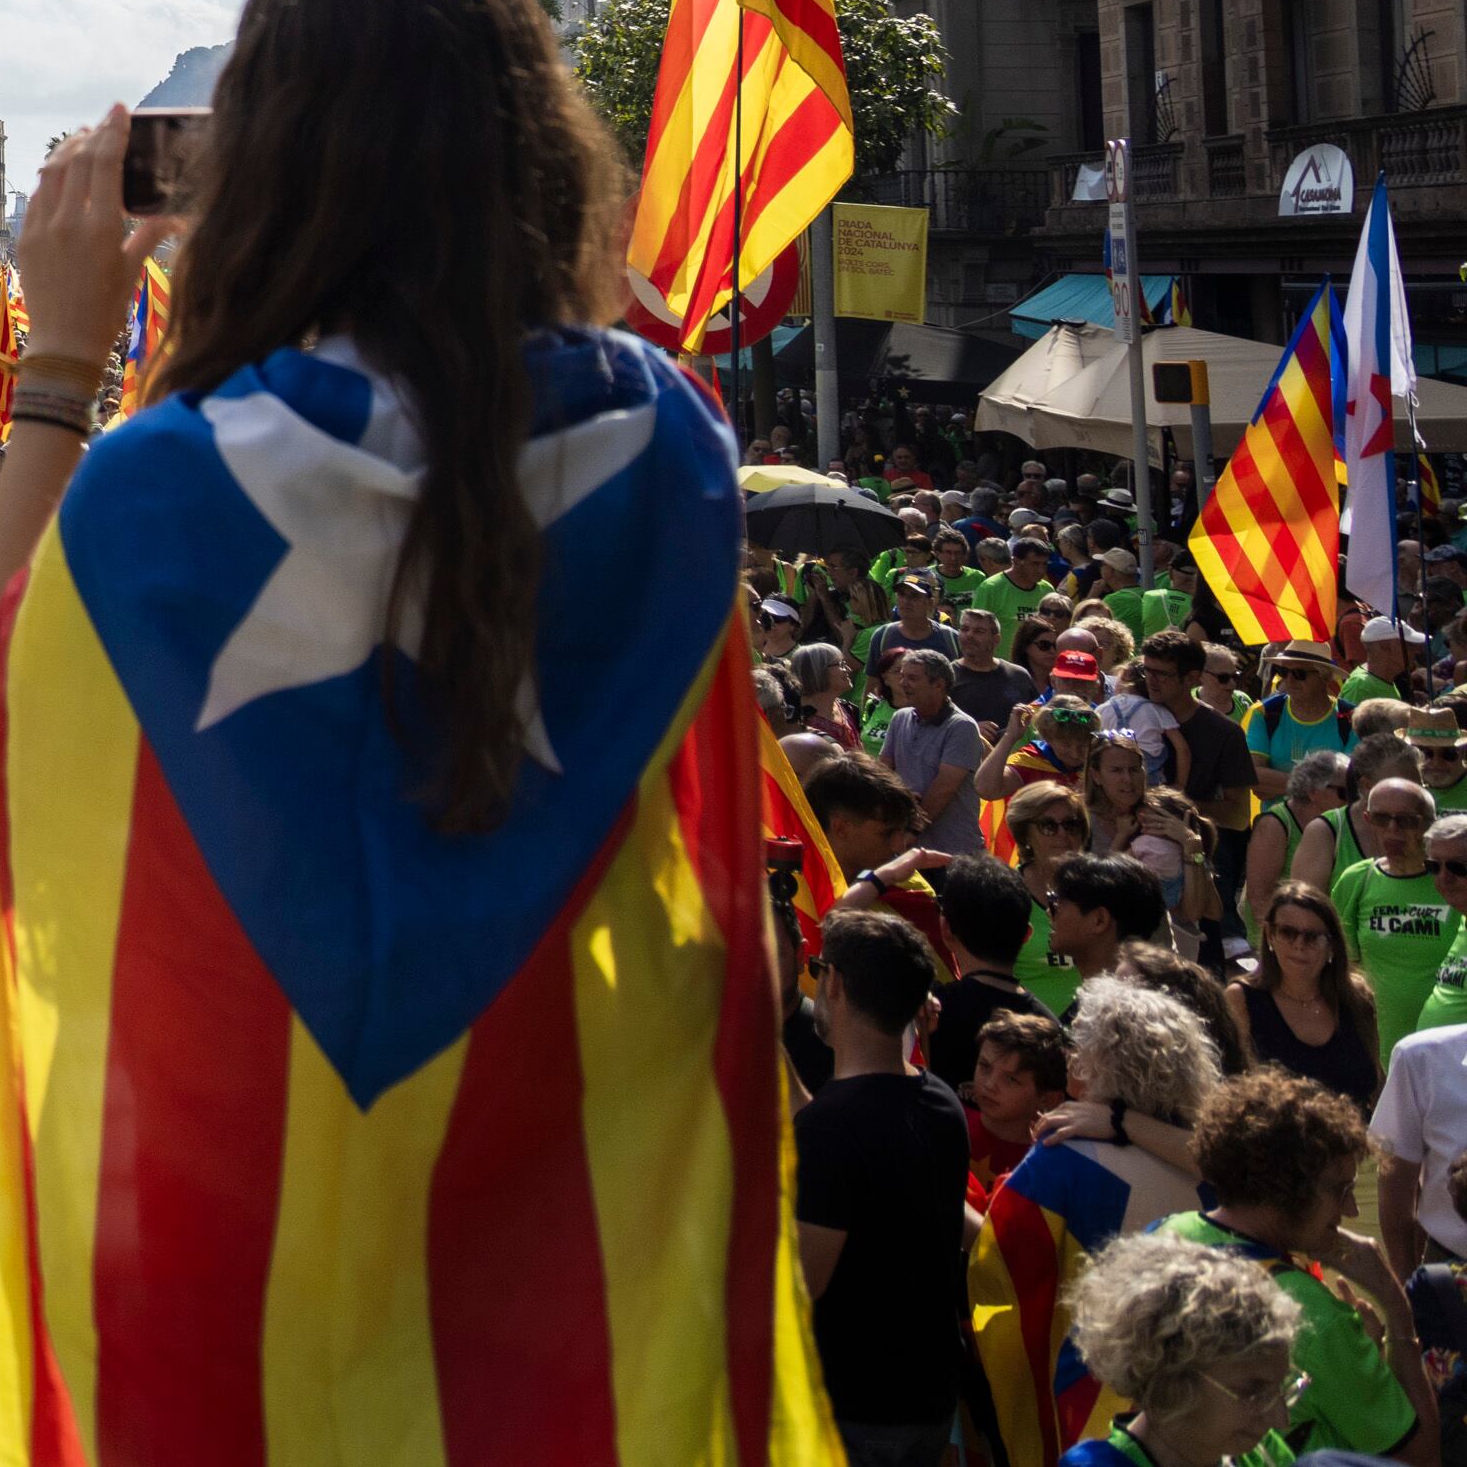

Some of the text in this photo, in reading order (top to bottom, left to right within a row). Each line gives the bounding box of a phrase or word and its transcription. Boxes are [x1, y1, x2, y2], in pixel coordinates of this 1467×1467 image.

[838, 220, 873, 230] DIADA
[838, 229, 895, 241] NACIONAL
[838, 237, 920, 251] DE CATALUNYA
[838, 246, 864, 256] 2024
[1372, 905, 1399, 916] FEM
[1369, 916, 1386, 932] EL
[1047, 952, 1069, 966] EL
